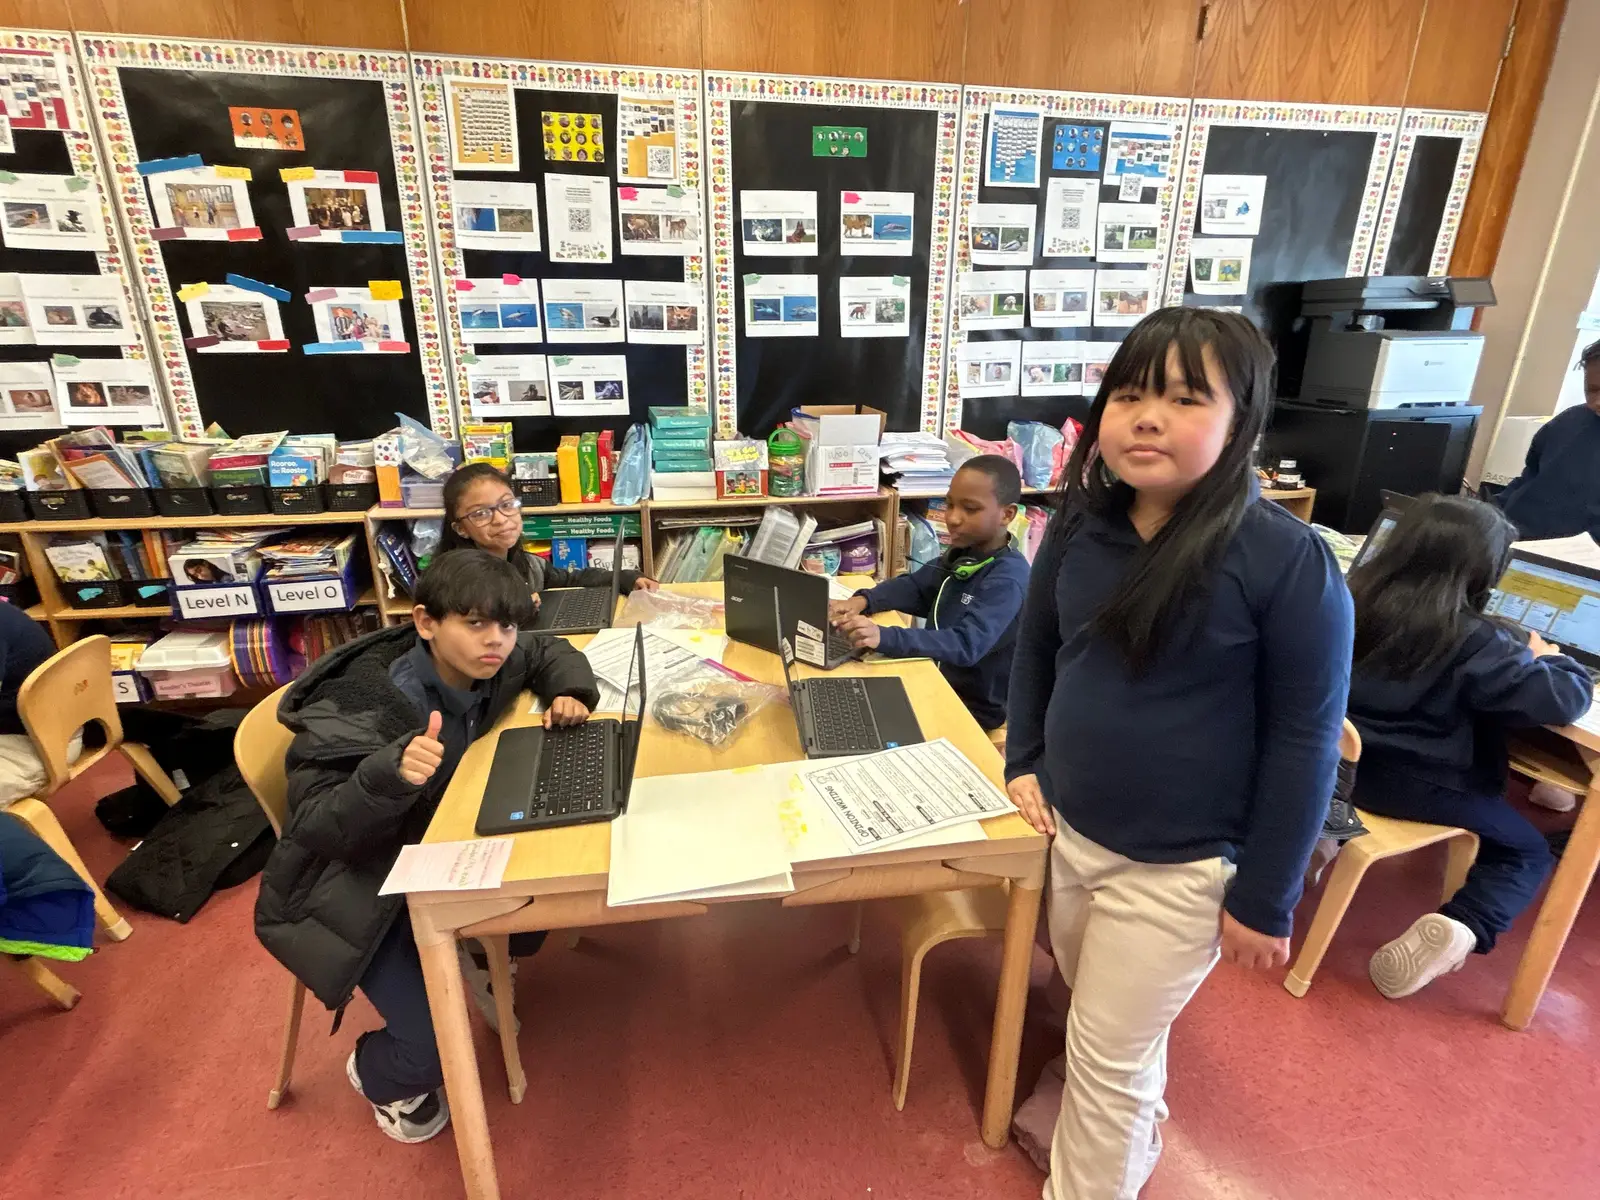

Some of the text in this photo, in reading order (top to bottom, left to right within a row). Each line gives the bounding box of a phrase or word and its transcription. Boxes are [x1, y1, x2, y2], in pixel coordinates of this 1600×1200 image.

[567, 516, 592, 524] Healthy
[185, 593, 249, 610] Level N
[276, 585, 338, 602] Level O
[117, 681, 130, 694] S
[824, 784, 868, 838] OPINION WRITING
